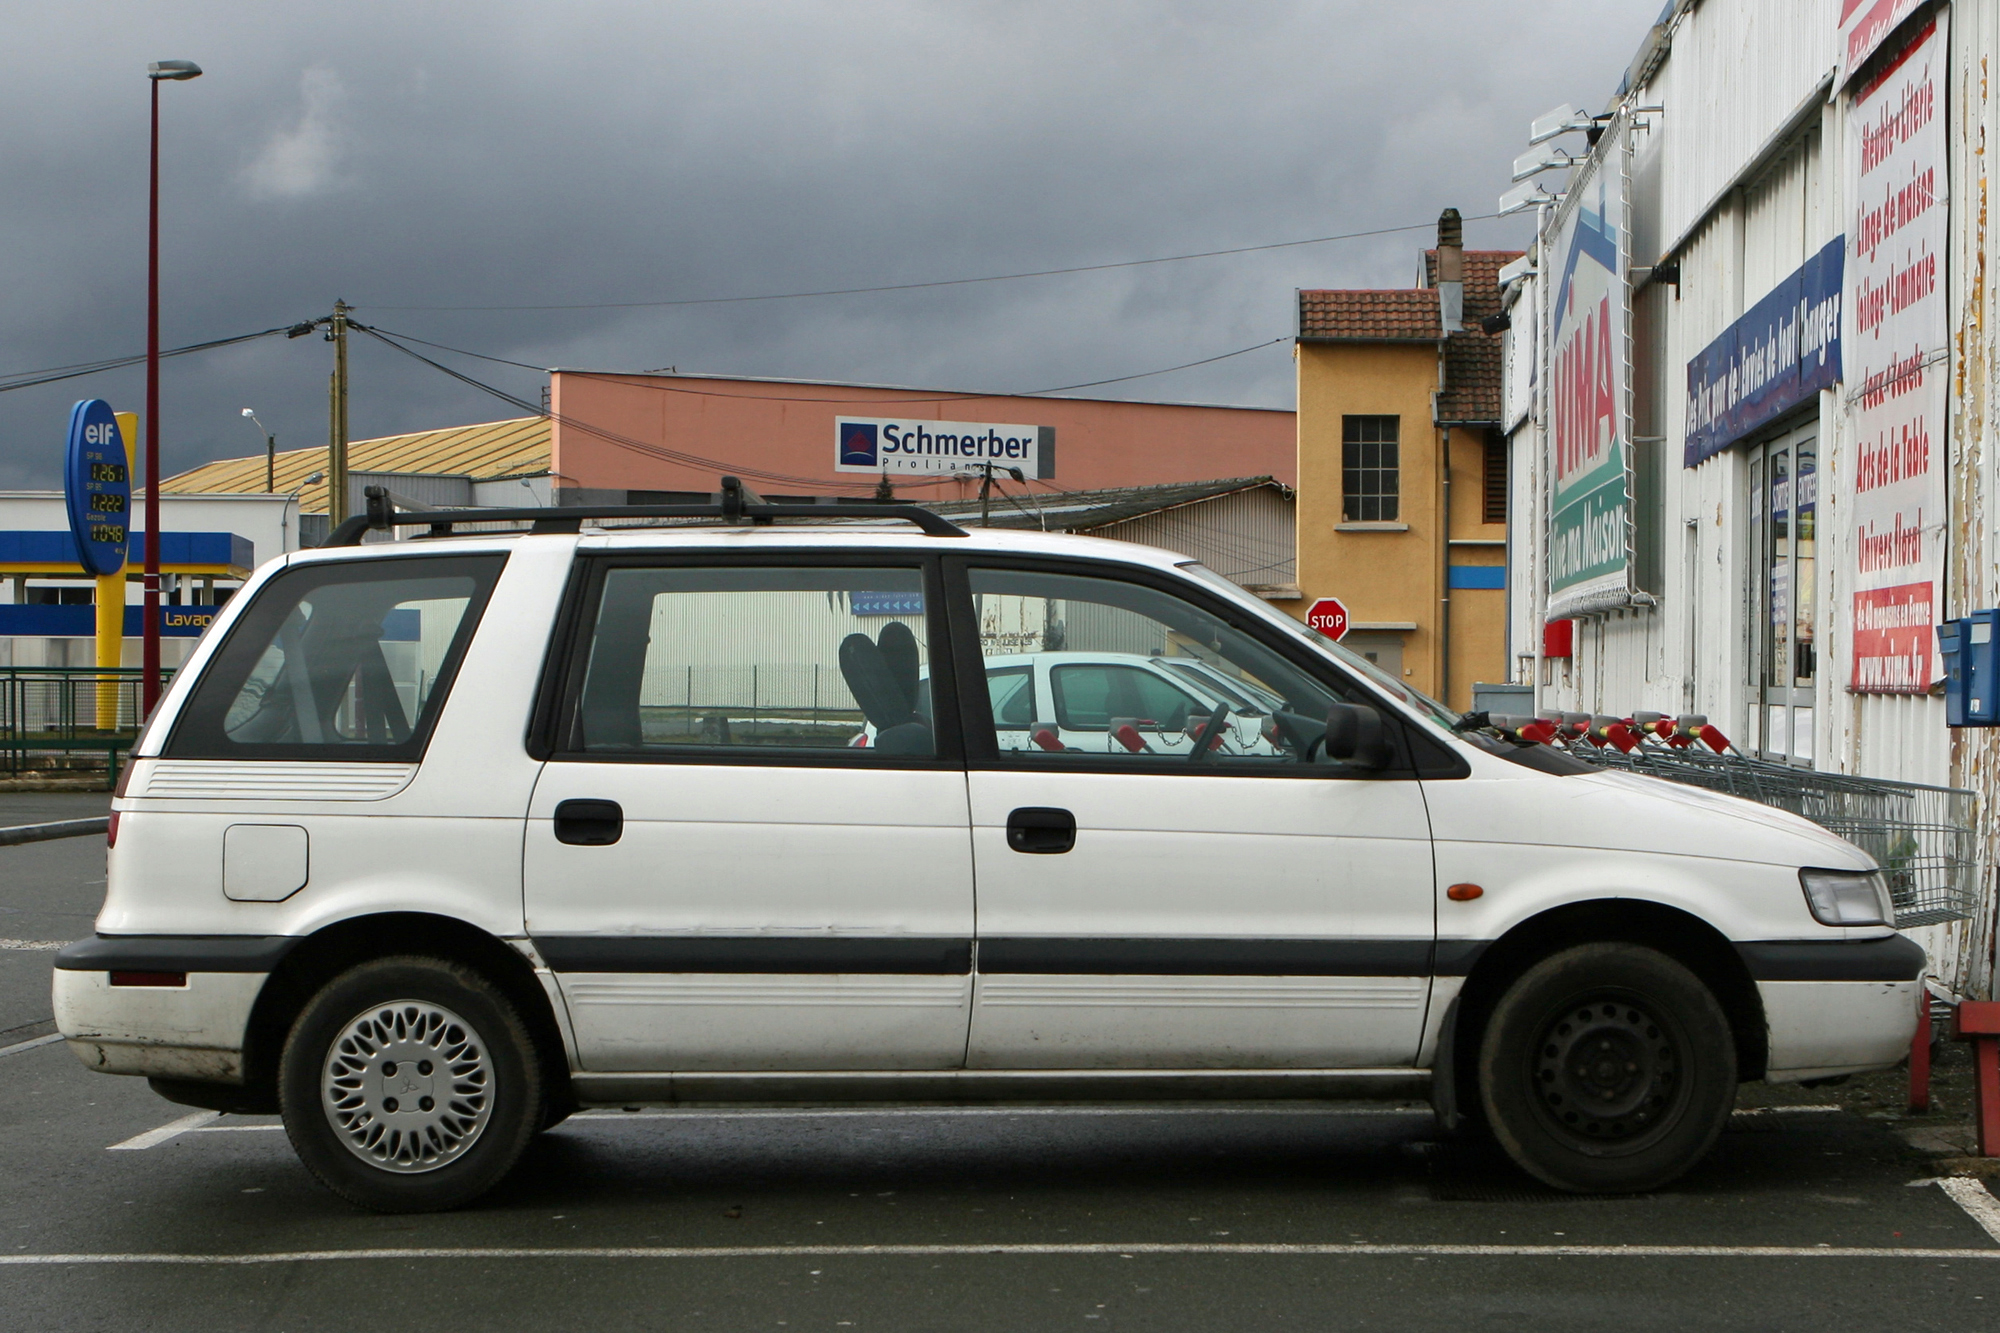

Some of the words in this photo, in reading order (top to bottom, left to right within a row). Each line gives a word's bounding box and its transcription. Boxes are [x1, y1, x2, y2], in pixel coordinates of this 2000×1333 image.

[1861, 100, 1894, 177] Meuble
[1901, 62, 1934, 144] Literie
[1857, 200, 1881, 264] Linge
[1884, 181, 1895, 240] de
[1898, 159, 1934, 230] maison
[1891, 238, 1935, 316] Luminaire
[1698, 373, 1711, 429] Prix
[1712, 374, 1726, 432] pour
[1741, 337, 1765, 400] Envies
[1766, 324, 1776, 382] de
[1778, 306, 1796, 374] tout
[1863, 366, 1885, 412] Jeux
[1891, 343, 1923, 400] Jouets
[85, 423, 114, 445] elf
[86, 452, 94, 460] SP
[882, 424, 1033, 459] Schmerber
[1856, 442, 1875, 494] Arts
[1877, 431, 1889, 489] de
[1890, 426, 1900, 484] la
[1902, 414, 1929, 480] Table
[92, 464, 123, 482] 1.261
[86, 513, 106, 522] Gazole
[92, 494, 123, 512] 1.222
[92, 525, 123, 543] 1.048
[1567, 525, 1581, 577] ma
[1582, 495, 1624, 571] Maison
[1858, 519, 1892, 575] Univers
[1894, 507, 1922, 567] floral
[1311, 615, 1344, 629] STOP
[1900, 603, 1908, 627] en
[1909, 594, 1930, 627] France
[1859, 636, 1923, 691] www.vima.fr
